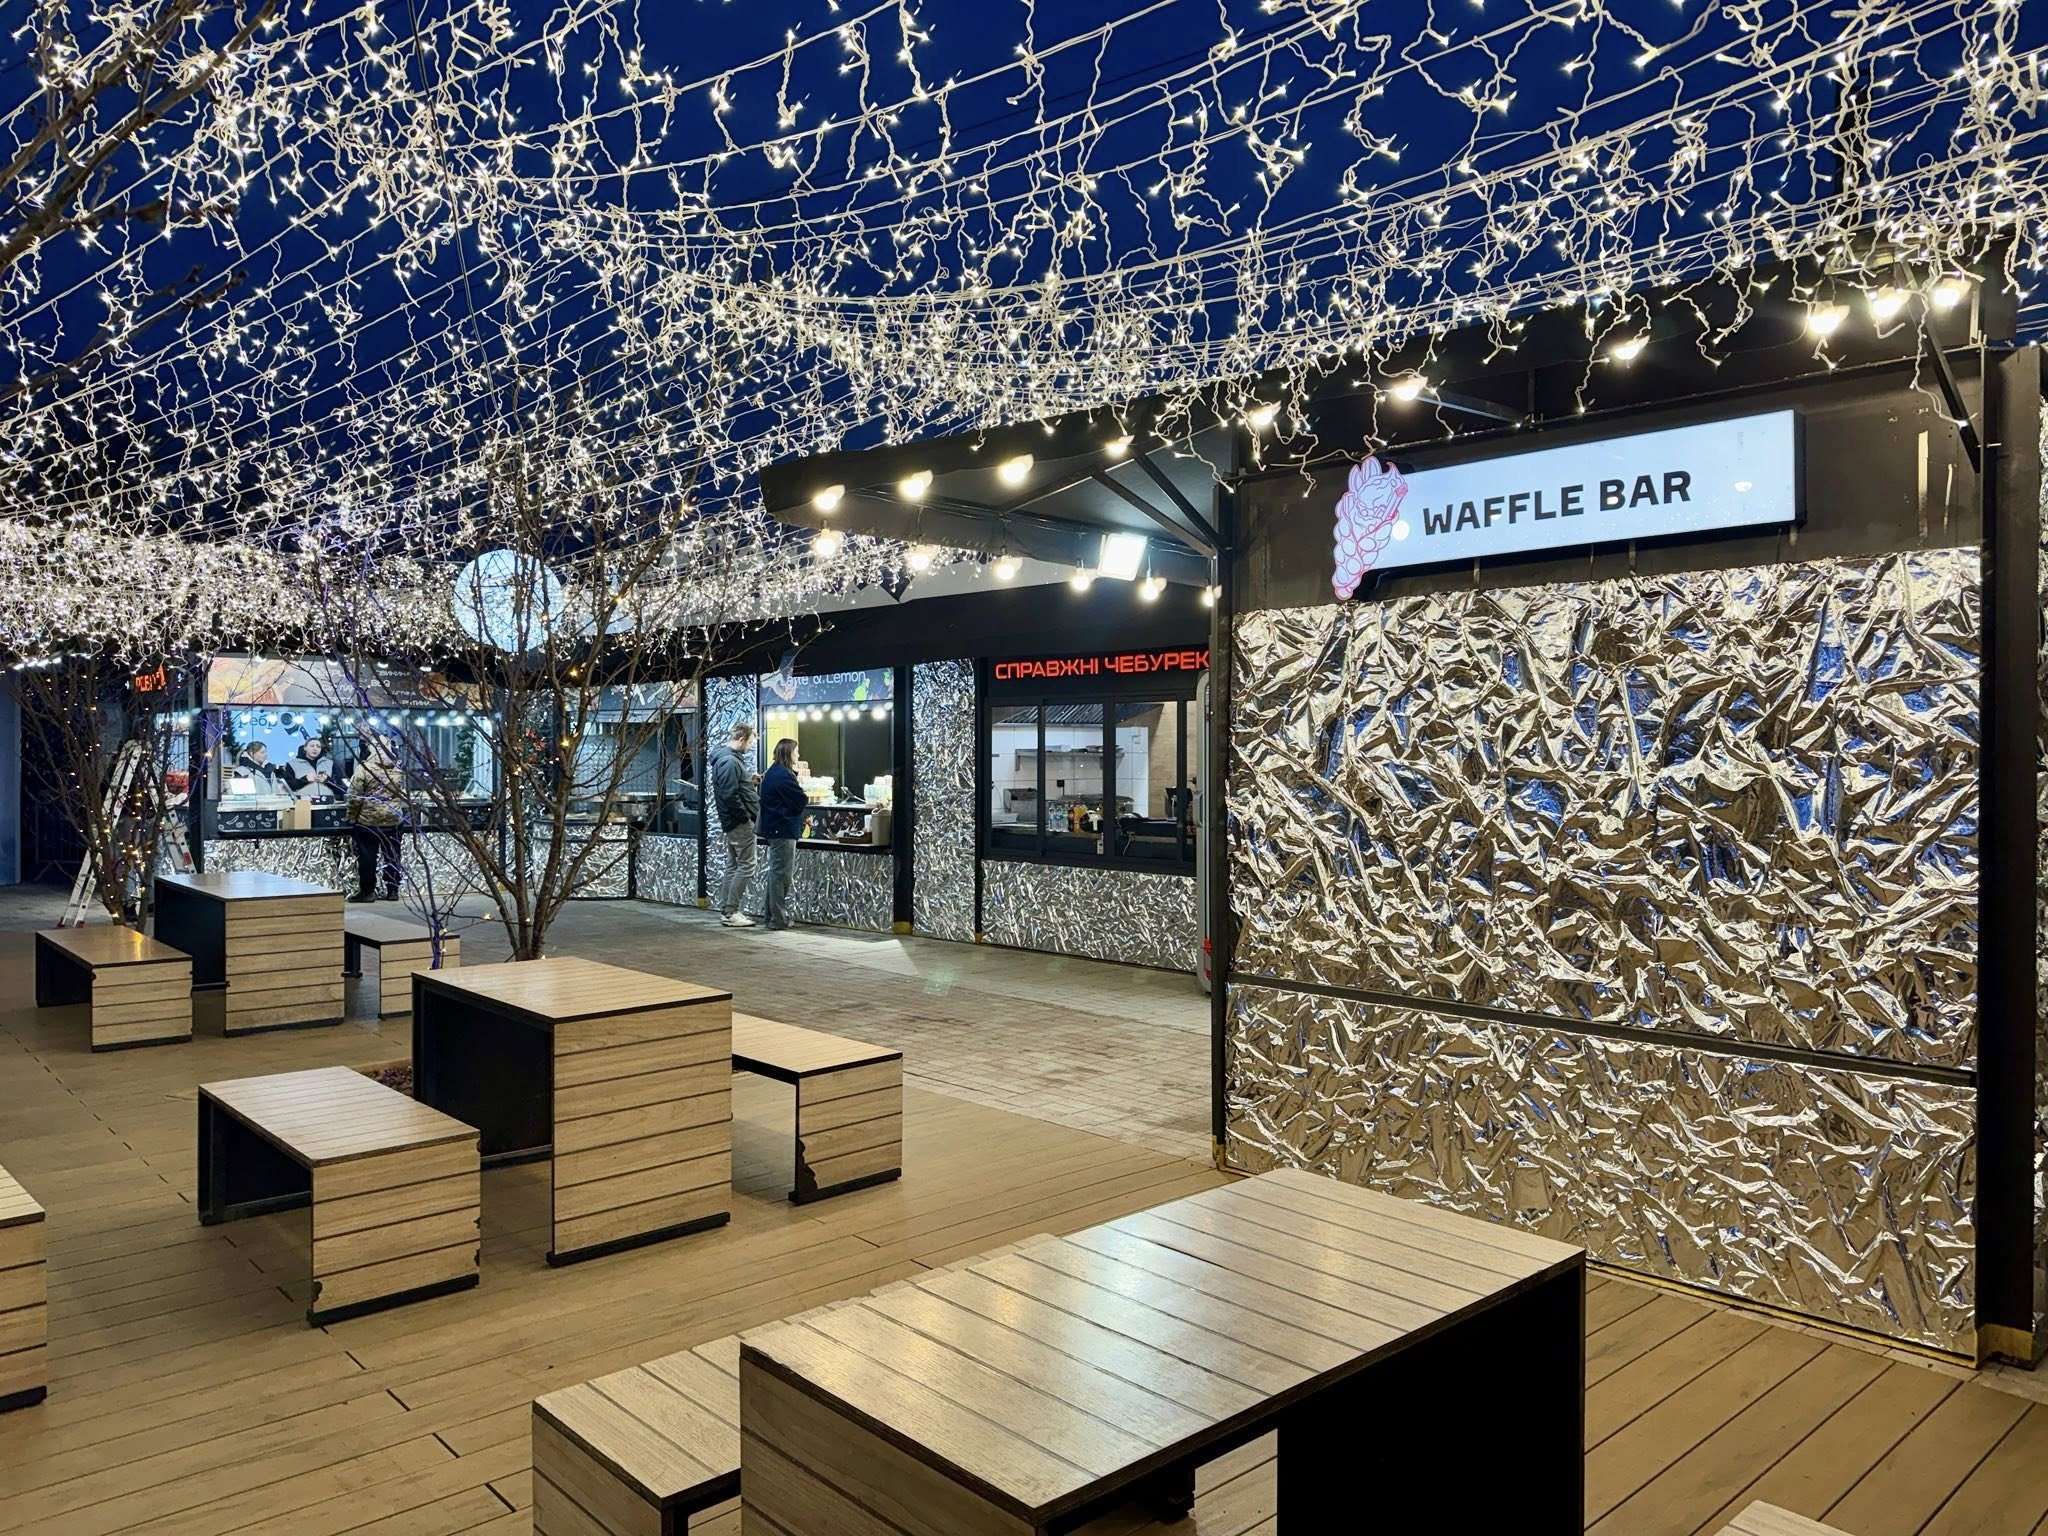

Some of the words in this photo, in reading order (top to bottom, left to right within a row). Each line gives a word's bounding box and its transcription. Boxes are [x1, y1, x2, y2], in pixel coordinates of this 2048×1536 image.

[1423, 484, 1584, 535] WAFFLE
[1600, 471, 1691, 511] BAR
[826, 671, 866, 684] Lemon
[995, 658, 1099, 680] СПРАВЖНІ
